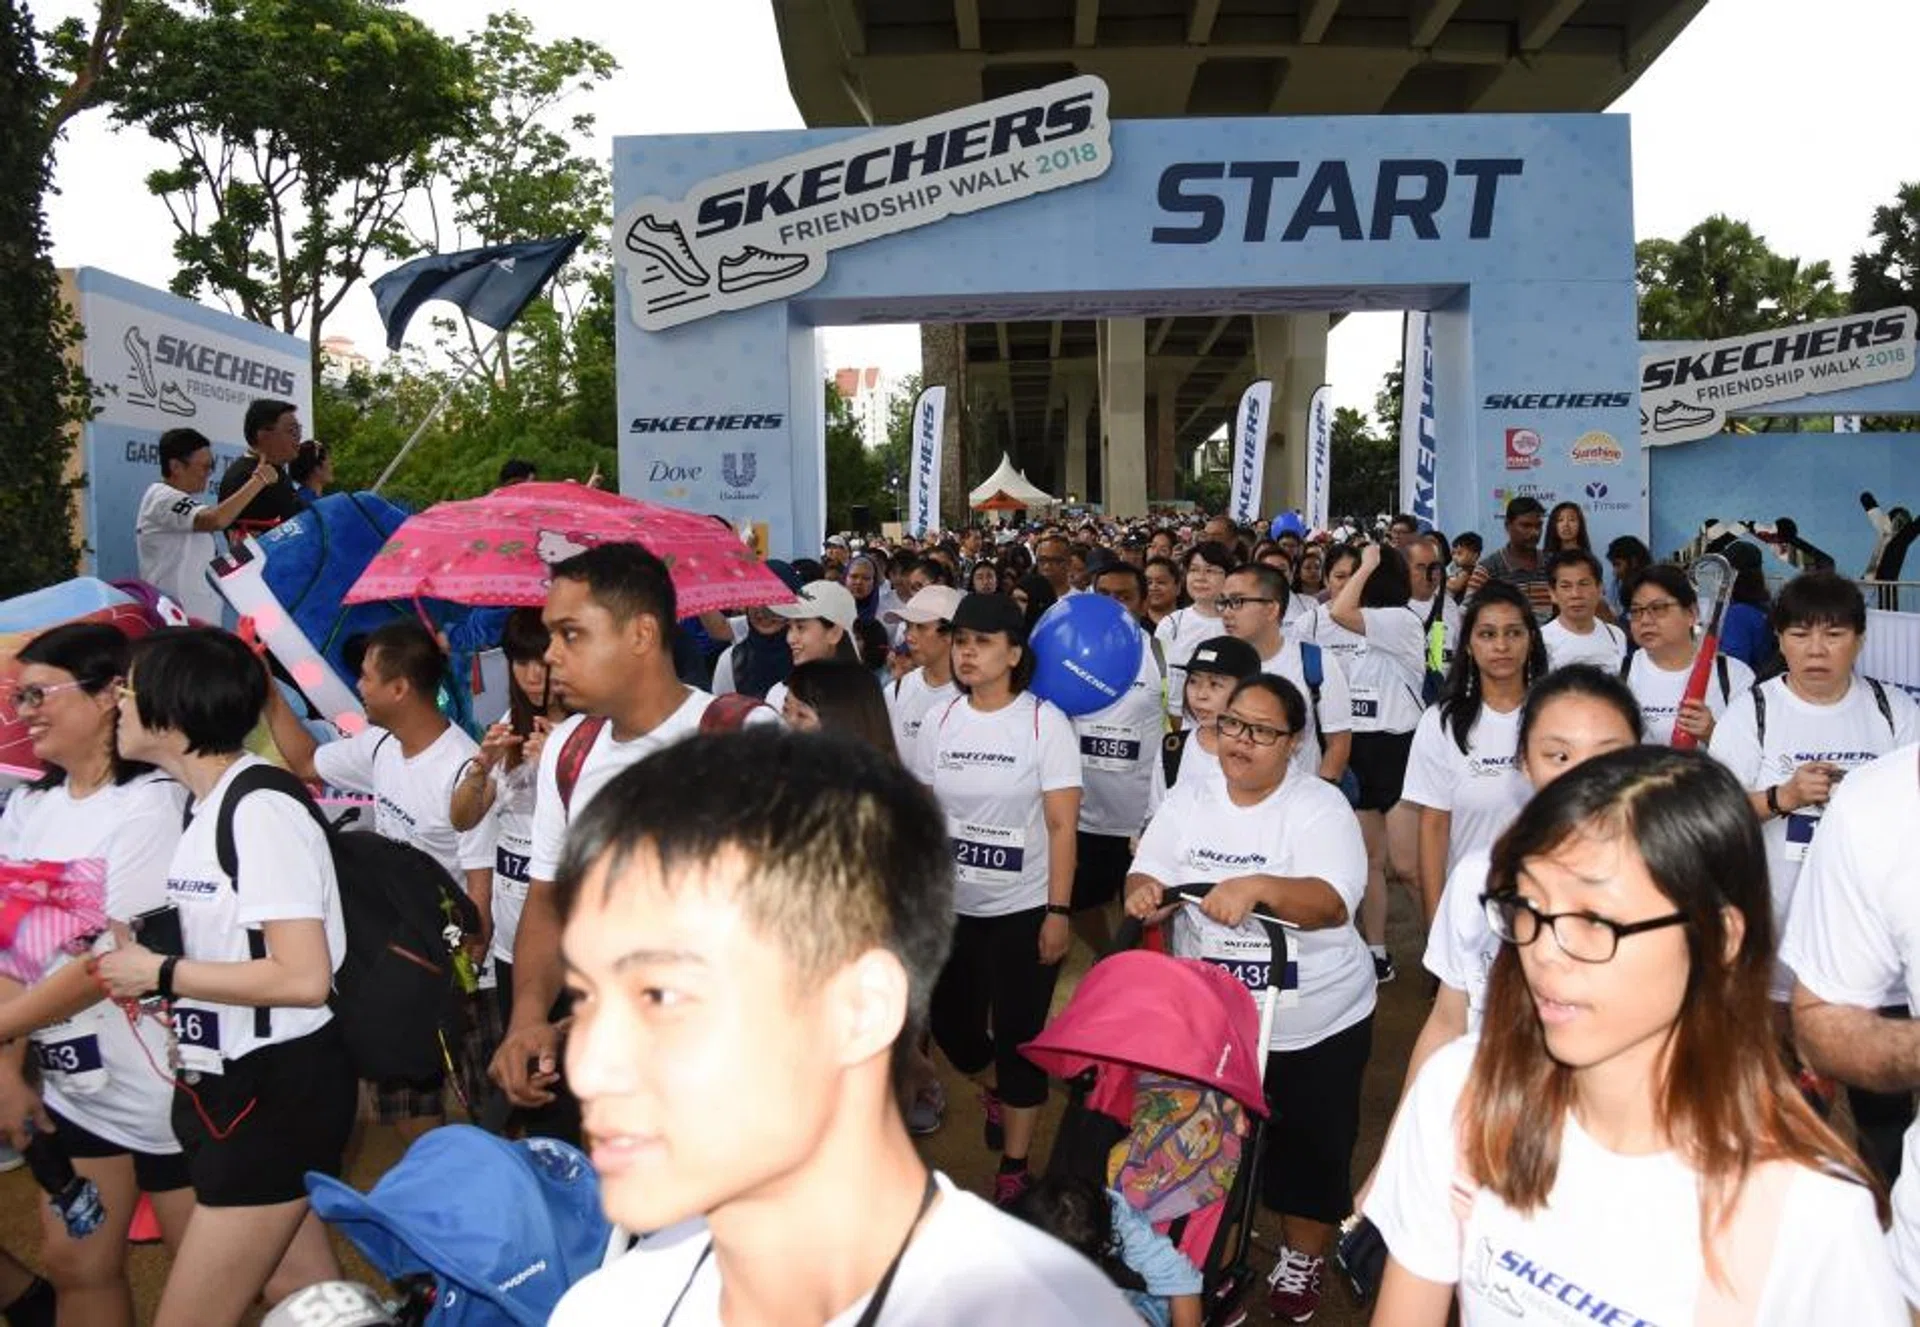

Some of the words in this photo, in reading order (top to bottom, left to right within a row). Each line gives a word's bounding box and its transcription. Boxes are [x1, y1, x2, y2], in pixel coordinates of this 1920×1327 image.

[696, 92, 1093, 239] SKECHERS
[779, 184, 943, 245] FRIENDSHIP
[949, 161, 1030, 198] WALK
[1035, 142, 1098, 175] 2018
[1151, 159, 1524, 244] START
[153, 333, 296, 397] SKECHERS
[1641, 313, 1907, 391] SKECHERS
[1697, 368, 1806, 402] FRIENDSHIP
[1809, 356, 1862, 382] WALK
[1865, 348, 1907, 369] 2018
[630, 413, 785, 434] SKECHERS
[1482, 391, 1632, 410] SKECHERS
[650, 459, 703, 482] Dove
[1062, 659, 1119, 698] SKECHERS
[1090, 739, 1130, 758] 1355
[956, 842, 1007, 868] 2110
